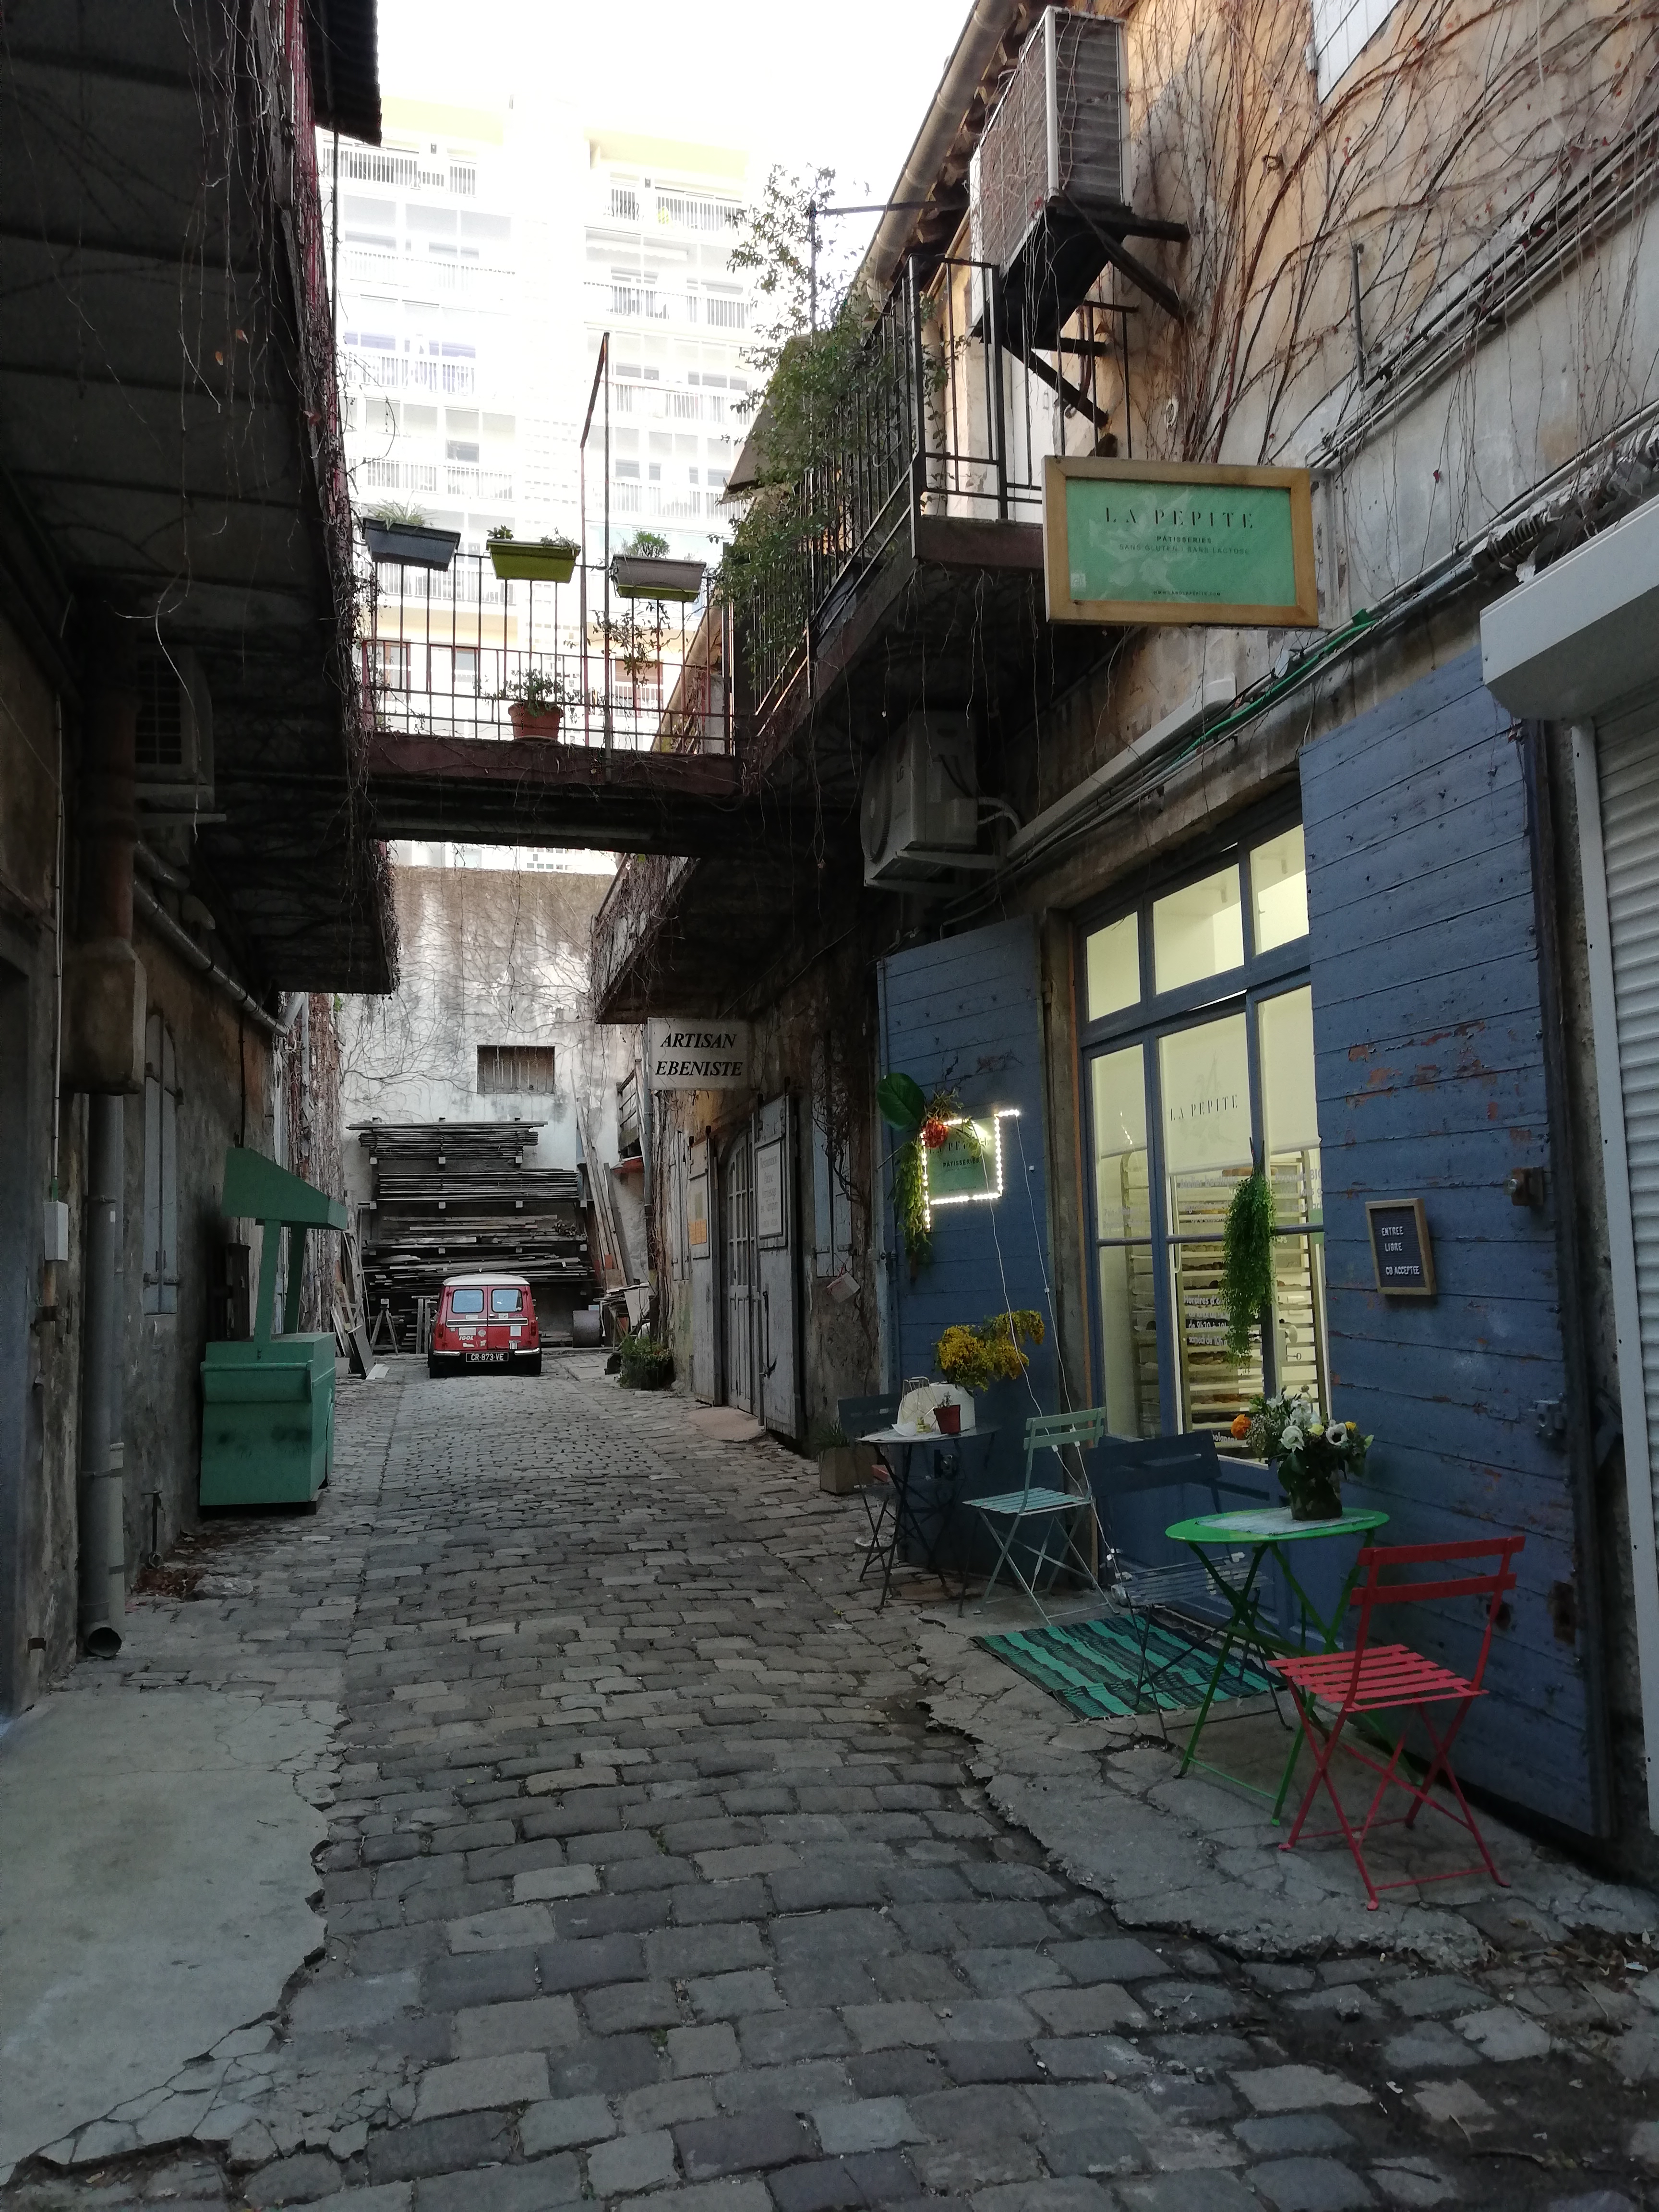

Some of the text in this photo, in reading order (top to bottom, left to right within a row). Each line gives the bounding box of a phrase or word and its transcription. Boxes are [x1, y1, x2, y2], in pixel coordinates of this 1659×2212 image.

[1106, 507, 1136, 523] LA
[660, 1033, 737, 1048] ARTISAN
[655, 1061, 743, 1076] EBENISTE
[1170, 1107, 1184, 1121] LA
[1381, 1226, 1404, 1237] ENTREE
[1184, 1295, 1209, 1305] Horaires
